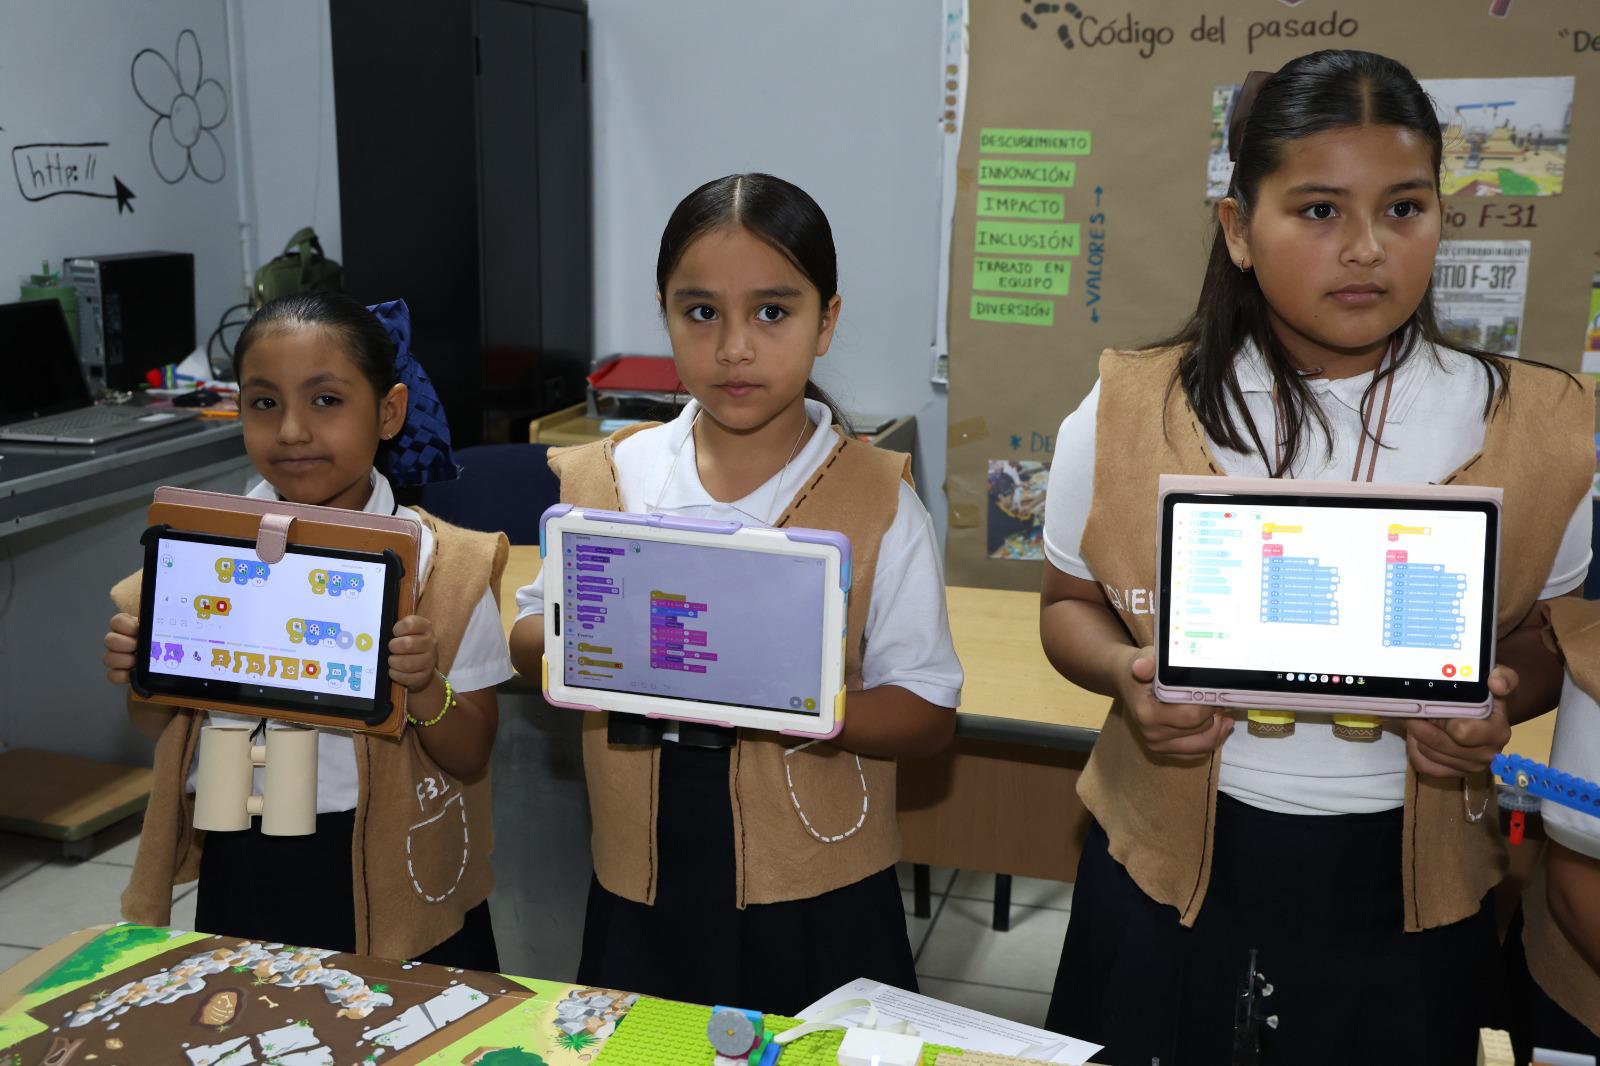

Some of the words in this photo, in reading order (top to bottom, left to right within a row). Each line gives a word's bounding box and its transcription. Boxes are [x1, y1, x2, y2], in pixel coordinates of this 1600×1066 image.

[1079, 12, 1174, 59] Código
[1190, 14, 1226, 44] del
[1248, 10, 1358, 55] pasado
[981, 135, 1088, 150] DESCUBRIMIENTO
[980, 165, 1071, 184] INNOVACIÓN
[984, 196, 1061, 215] IMPACTO
[1478, 203, 1538, 229] F-31
[978, 230, 1074, 249] INCLUSIÓN
[976, 260, 1033, 274] TRABAJO
[1044, 262, 1065, 274] EN
[1086, 212, 1106, 306] VALORES
[998, 276, 1053, 290] EQUIPO
[1470, 264, 1517, 289] F-31?
[976, 302, 1050, 317] DIVERSIÓN
